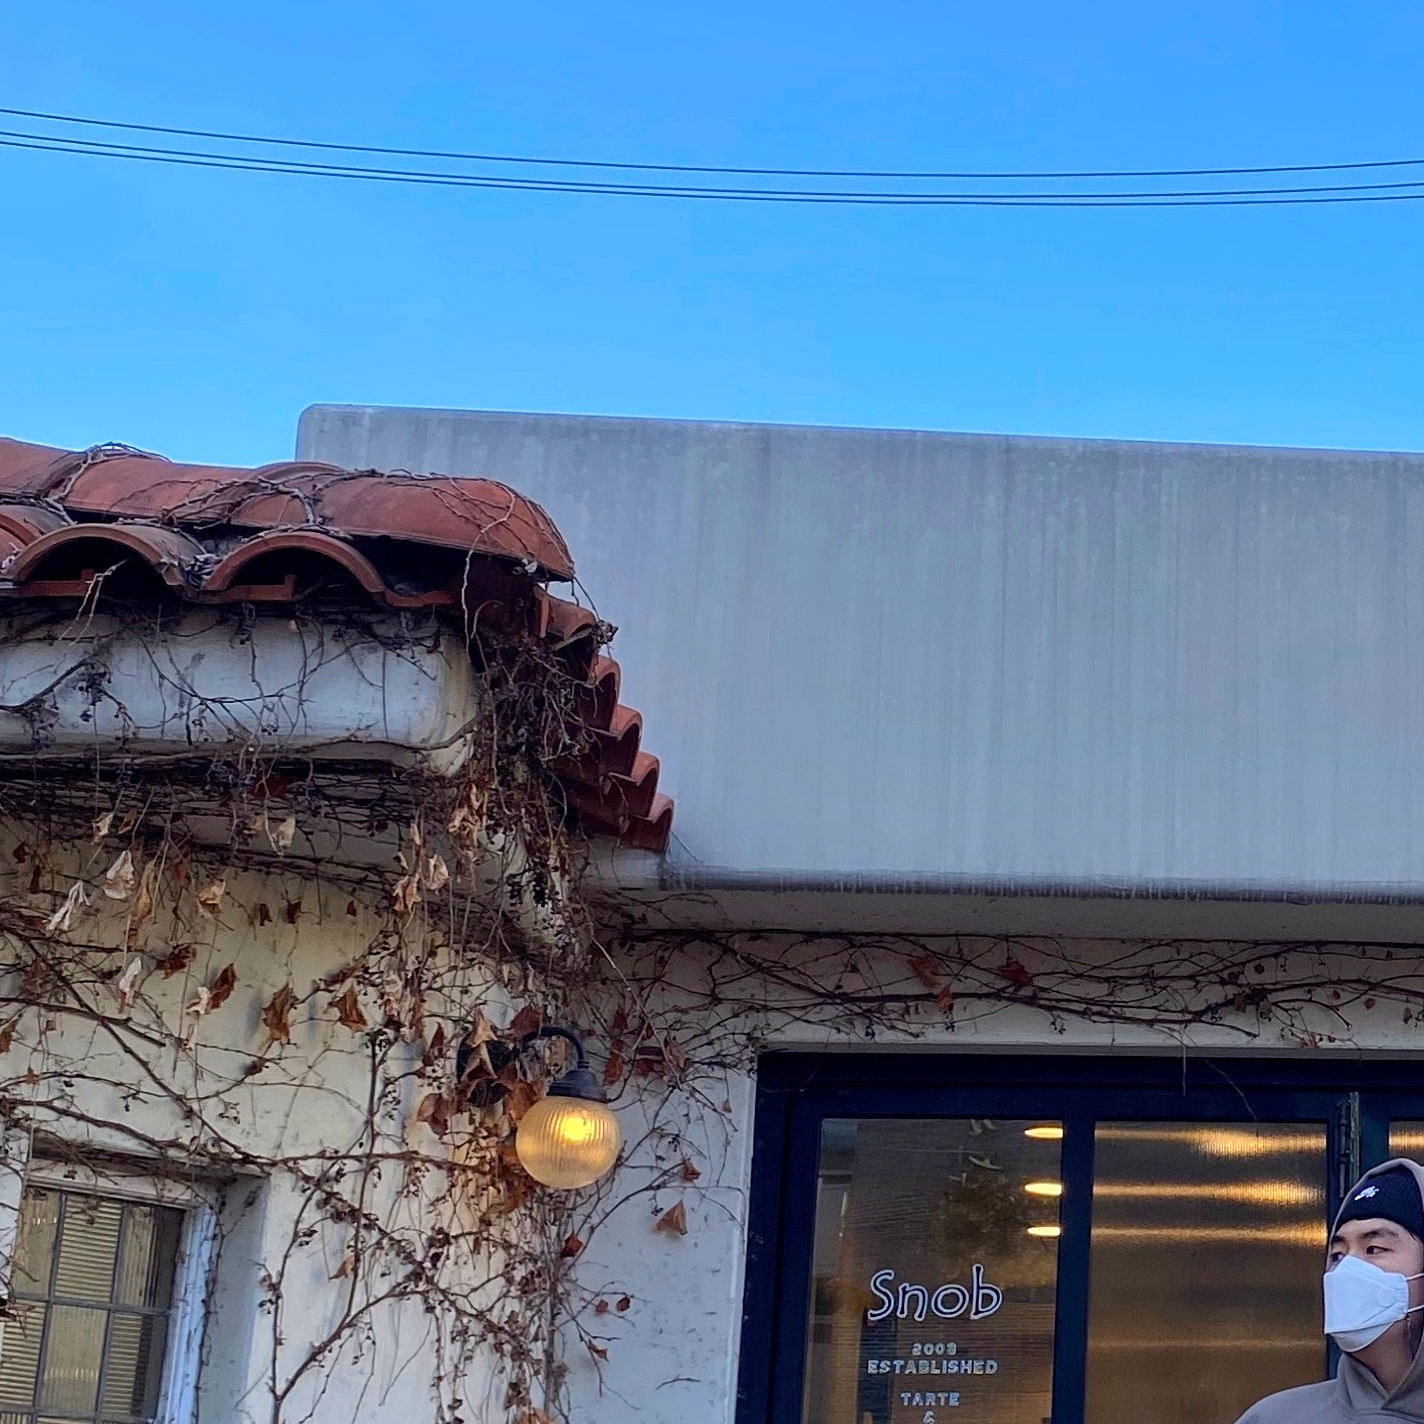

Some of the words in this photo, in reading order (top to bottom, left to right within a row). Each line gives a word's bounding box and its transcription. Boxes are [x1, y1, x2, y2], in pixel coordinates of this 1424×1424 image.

[867, 1264, 1003, 1321] Snob
[867, 1360, 998, 1375] ESTABLISHED
[900, 1392, 960, 1406] TARTE
[923, 1410, 935, 1424] &
